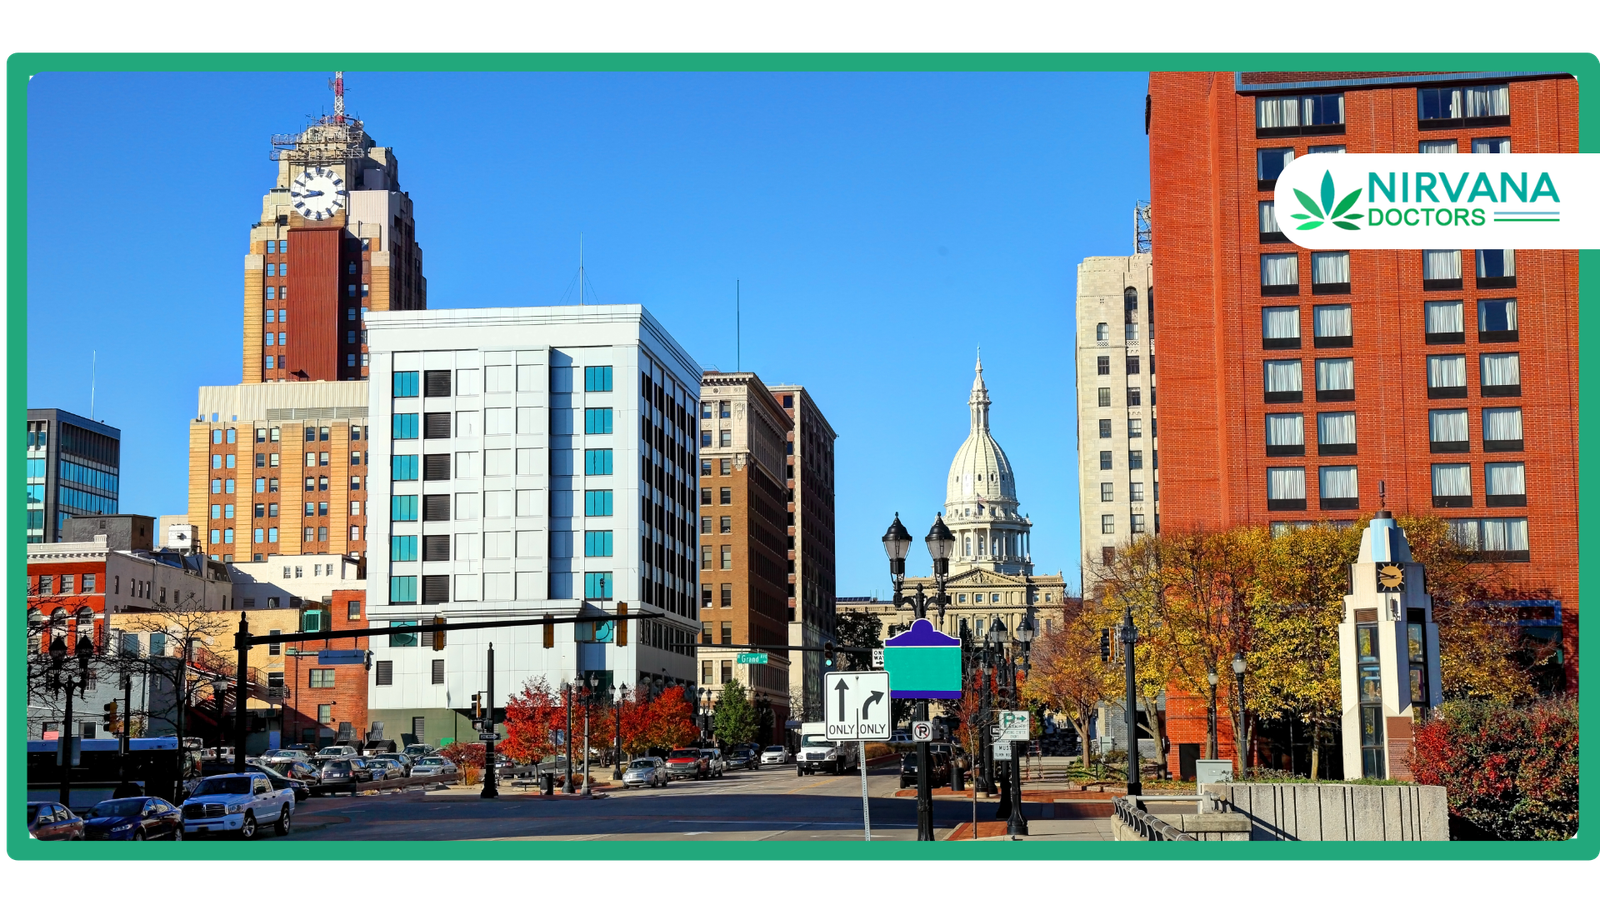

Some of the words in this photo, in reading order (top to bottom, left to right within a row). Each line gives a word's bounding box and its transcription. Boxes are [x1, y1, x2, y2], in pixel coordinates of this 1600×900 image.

[741, 654, 759, 663] Grand
[829, 724, 855, 735] ONLY
[860, 723, 886, 734] ONLY
